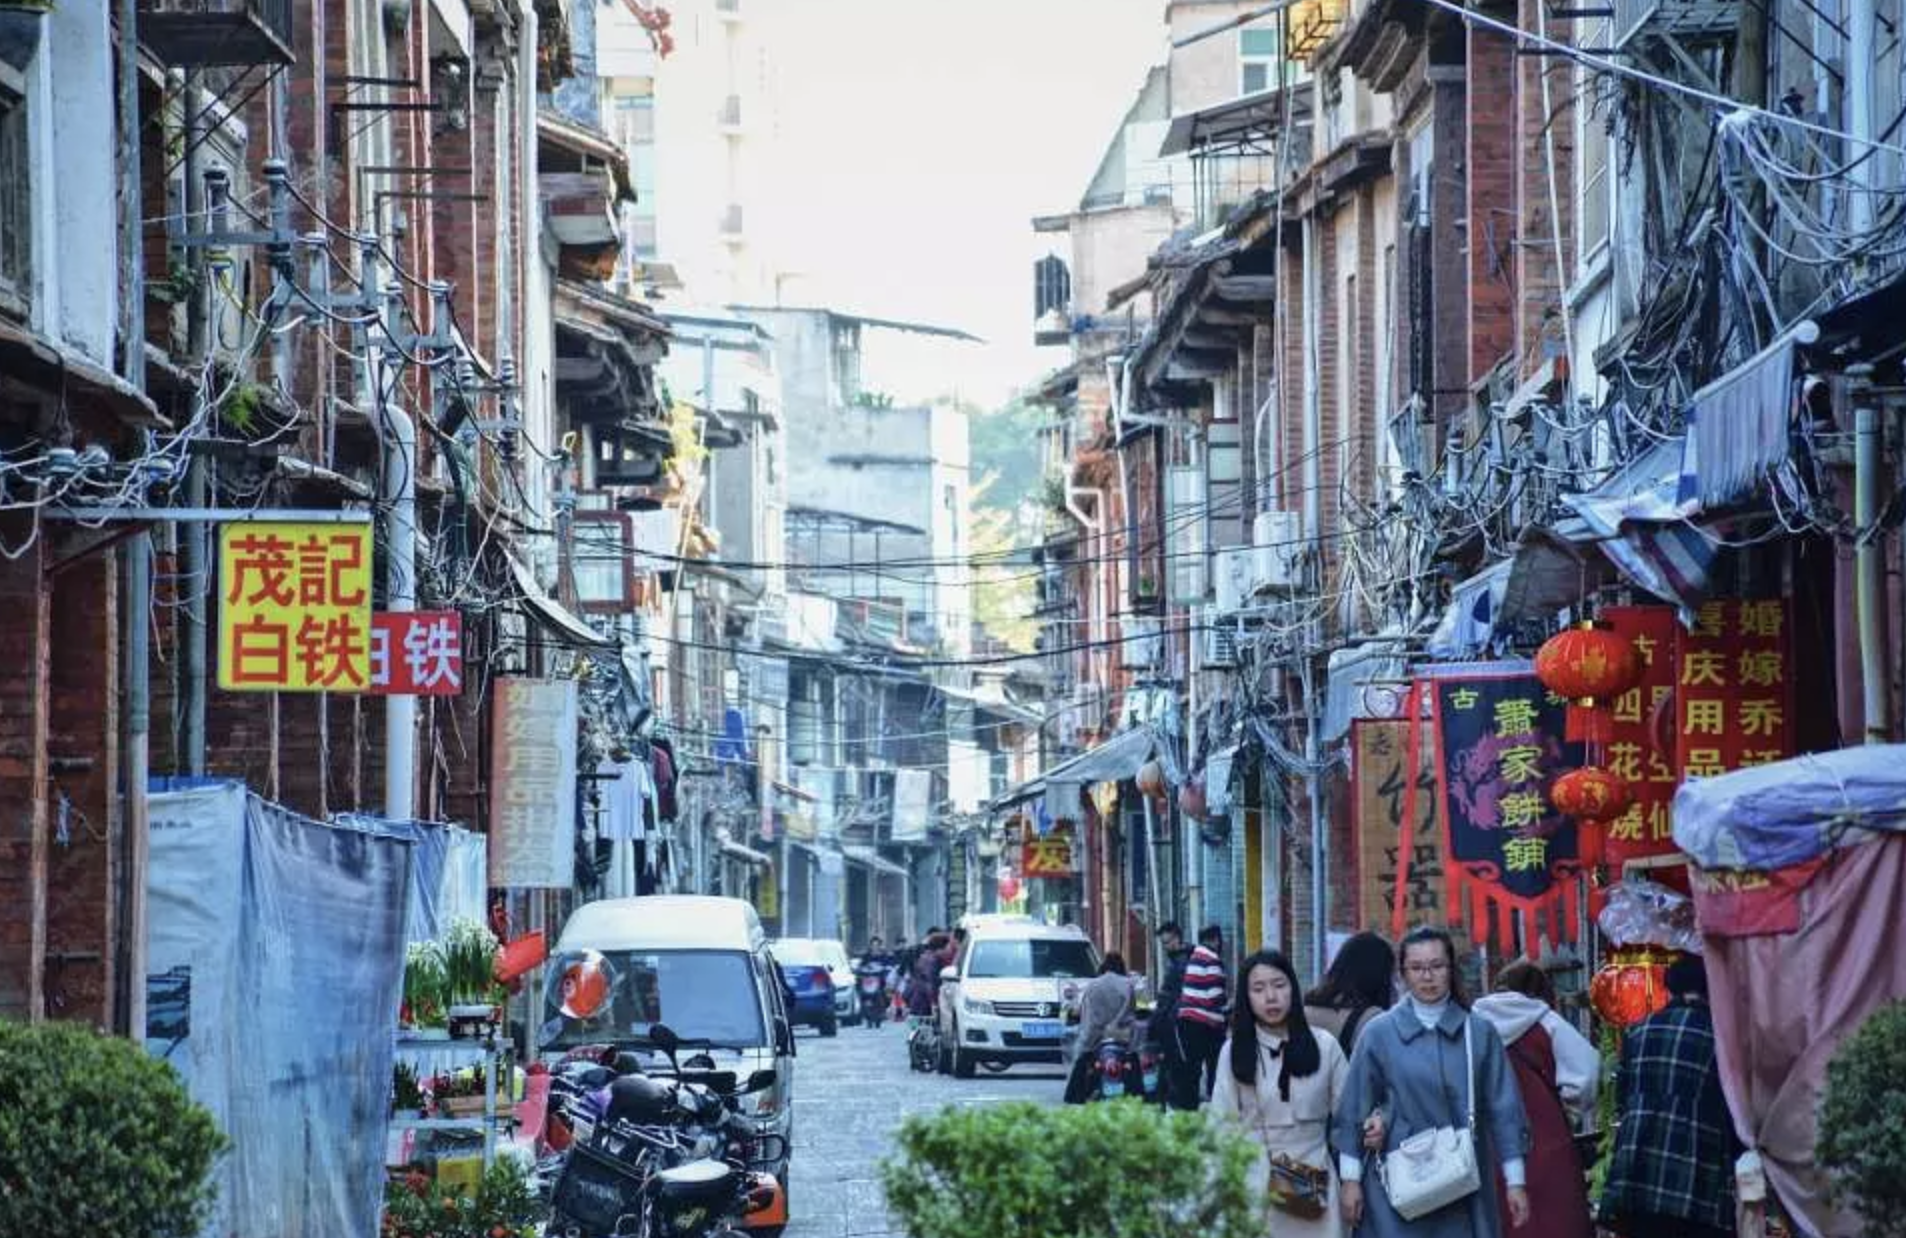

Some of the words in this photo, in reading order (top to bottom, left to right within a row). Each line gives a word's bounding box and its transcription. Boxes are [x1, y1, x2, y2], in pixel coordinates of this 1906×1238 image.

[229, 533, 366, 607] 茂記
[231, 614, 364, 687] 白铁
[1681, 601, 1726, 778] 喜庆用品
